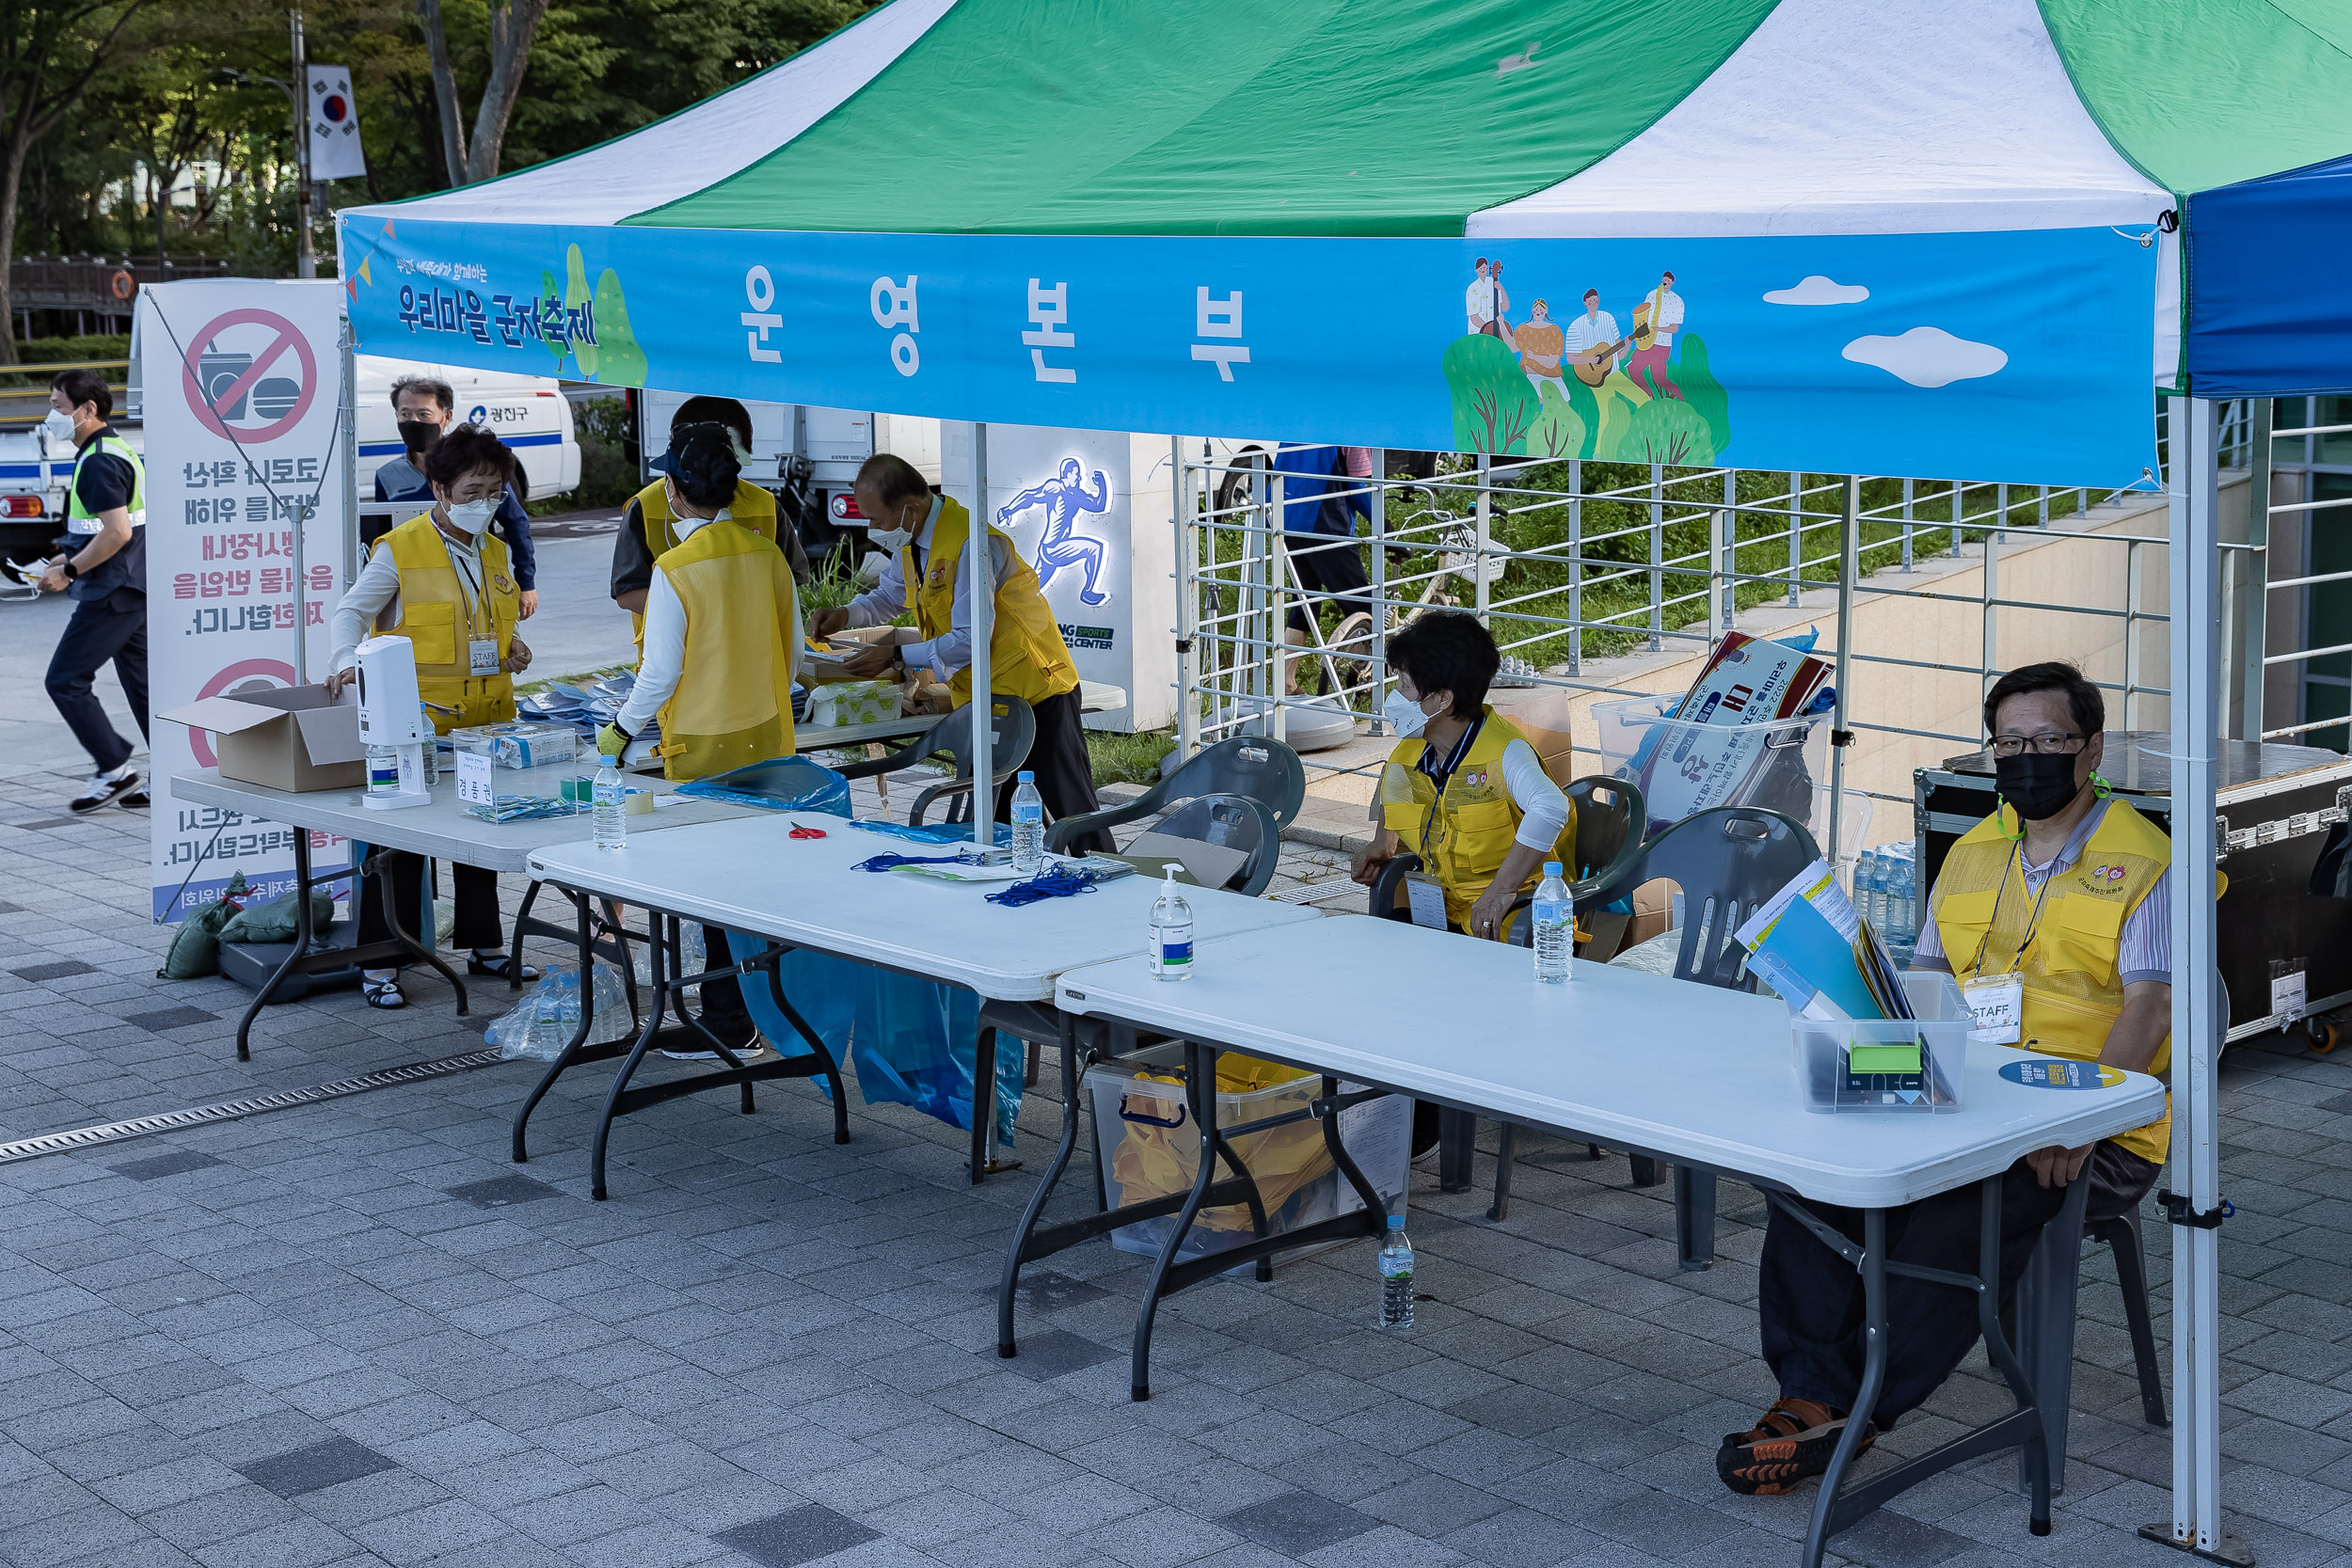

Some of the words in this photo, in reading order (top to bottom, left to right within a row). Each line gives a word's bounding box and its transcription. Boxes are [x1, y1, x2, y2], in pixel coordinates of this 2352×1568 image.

[452, 262, 487, 283] 함께하는
[399, 284, 493, 346] 우리마을
[492, 294, 600, 354] 군자축제
[489, 406, 529, 423] 광진구
[1077, 627, 1110, 639] SPORTS
[1074, 638, 1113, 651] CENTER
[473, 652, 496, 661] STAFF
[1756, 659, 1788, 704] 우리마을
[1769, 680, 1788, 704] 2022
[1679, 736, 1693, 752] PC
[1686, 751, 1732, 816] 주민노래자랑
[1707, 769, 1734, 806] 함께하는
[1972, 1004, 2010, 1019] STAFF
